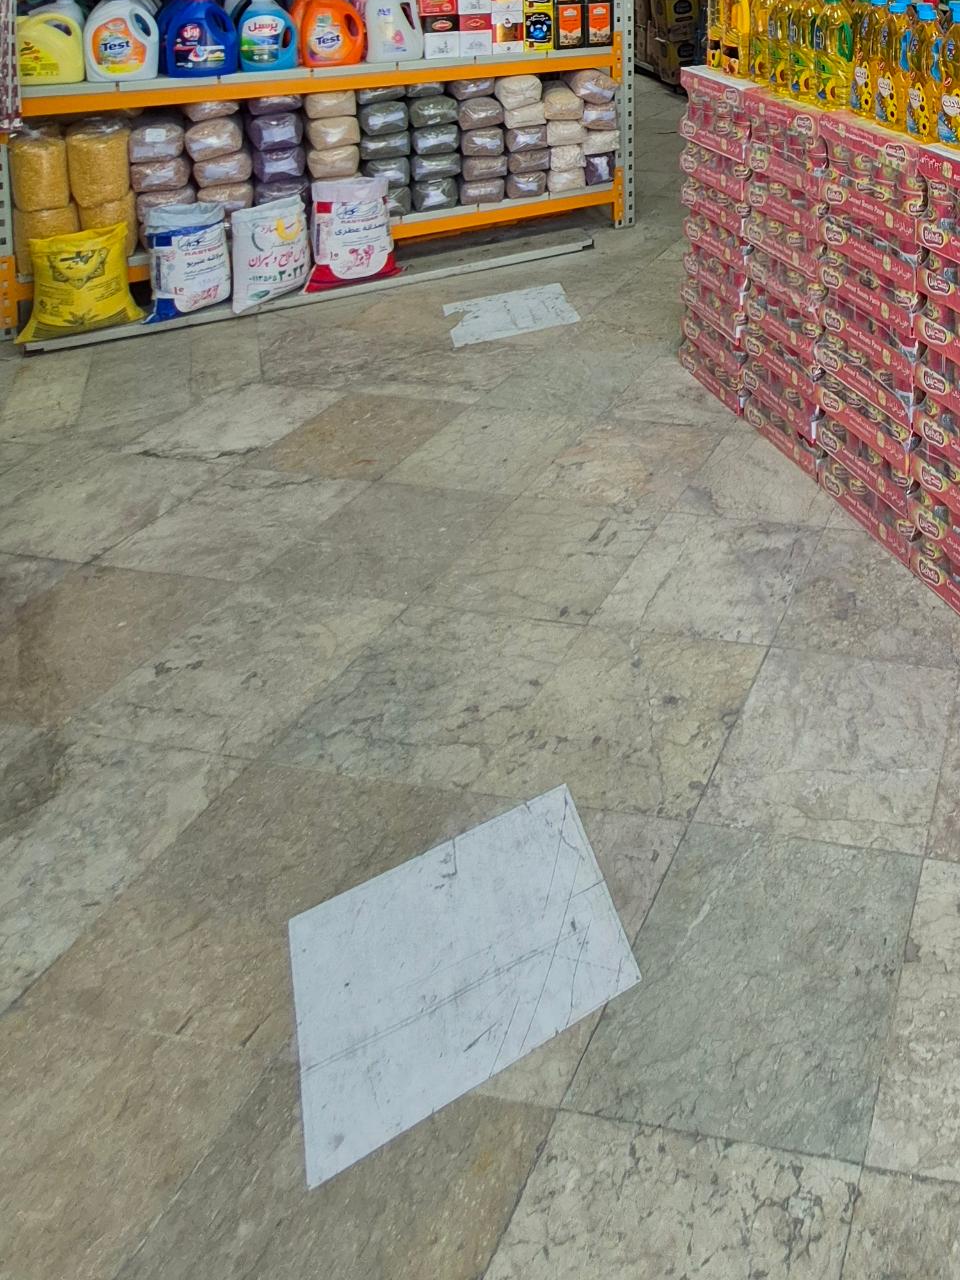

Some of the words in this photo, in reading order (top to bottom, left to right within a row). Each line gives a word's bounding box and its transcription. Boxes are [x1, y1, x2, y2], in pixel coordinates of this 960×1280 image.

[248, 22, 278, 33] پرسیل
[316, 34, 341, 45] Test
[101, 39, 130, 52] Test
